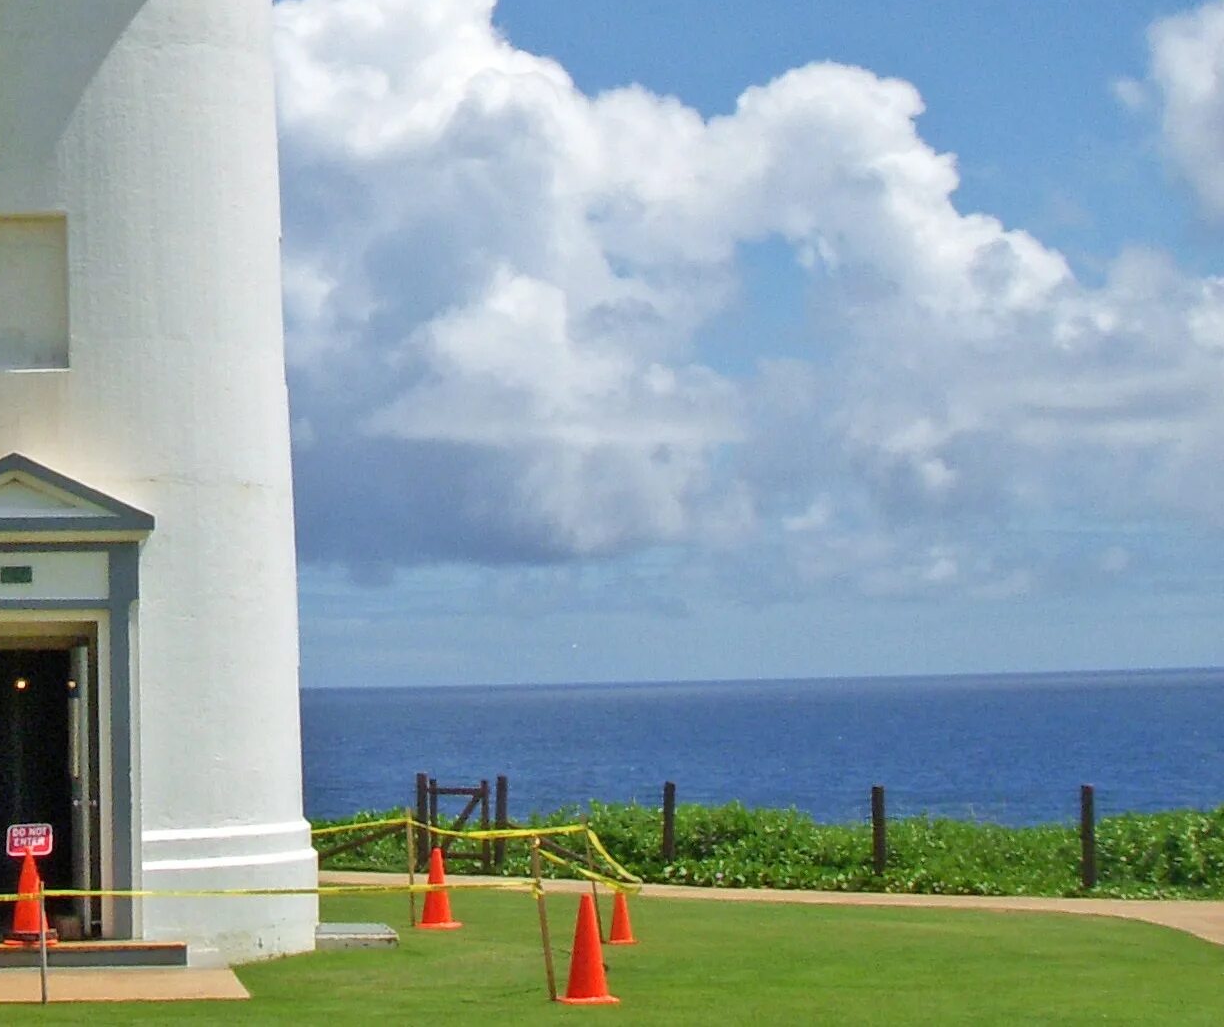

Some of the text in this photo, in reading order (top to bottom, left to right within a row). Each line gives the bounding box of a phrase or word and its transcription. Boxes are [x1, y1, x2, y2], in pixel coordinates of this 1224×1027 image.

[12, 827, 47, 837] DO NOT
[14, 837, 45, 846] ENTER
